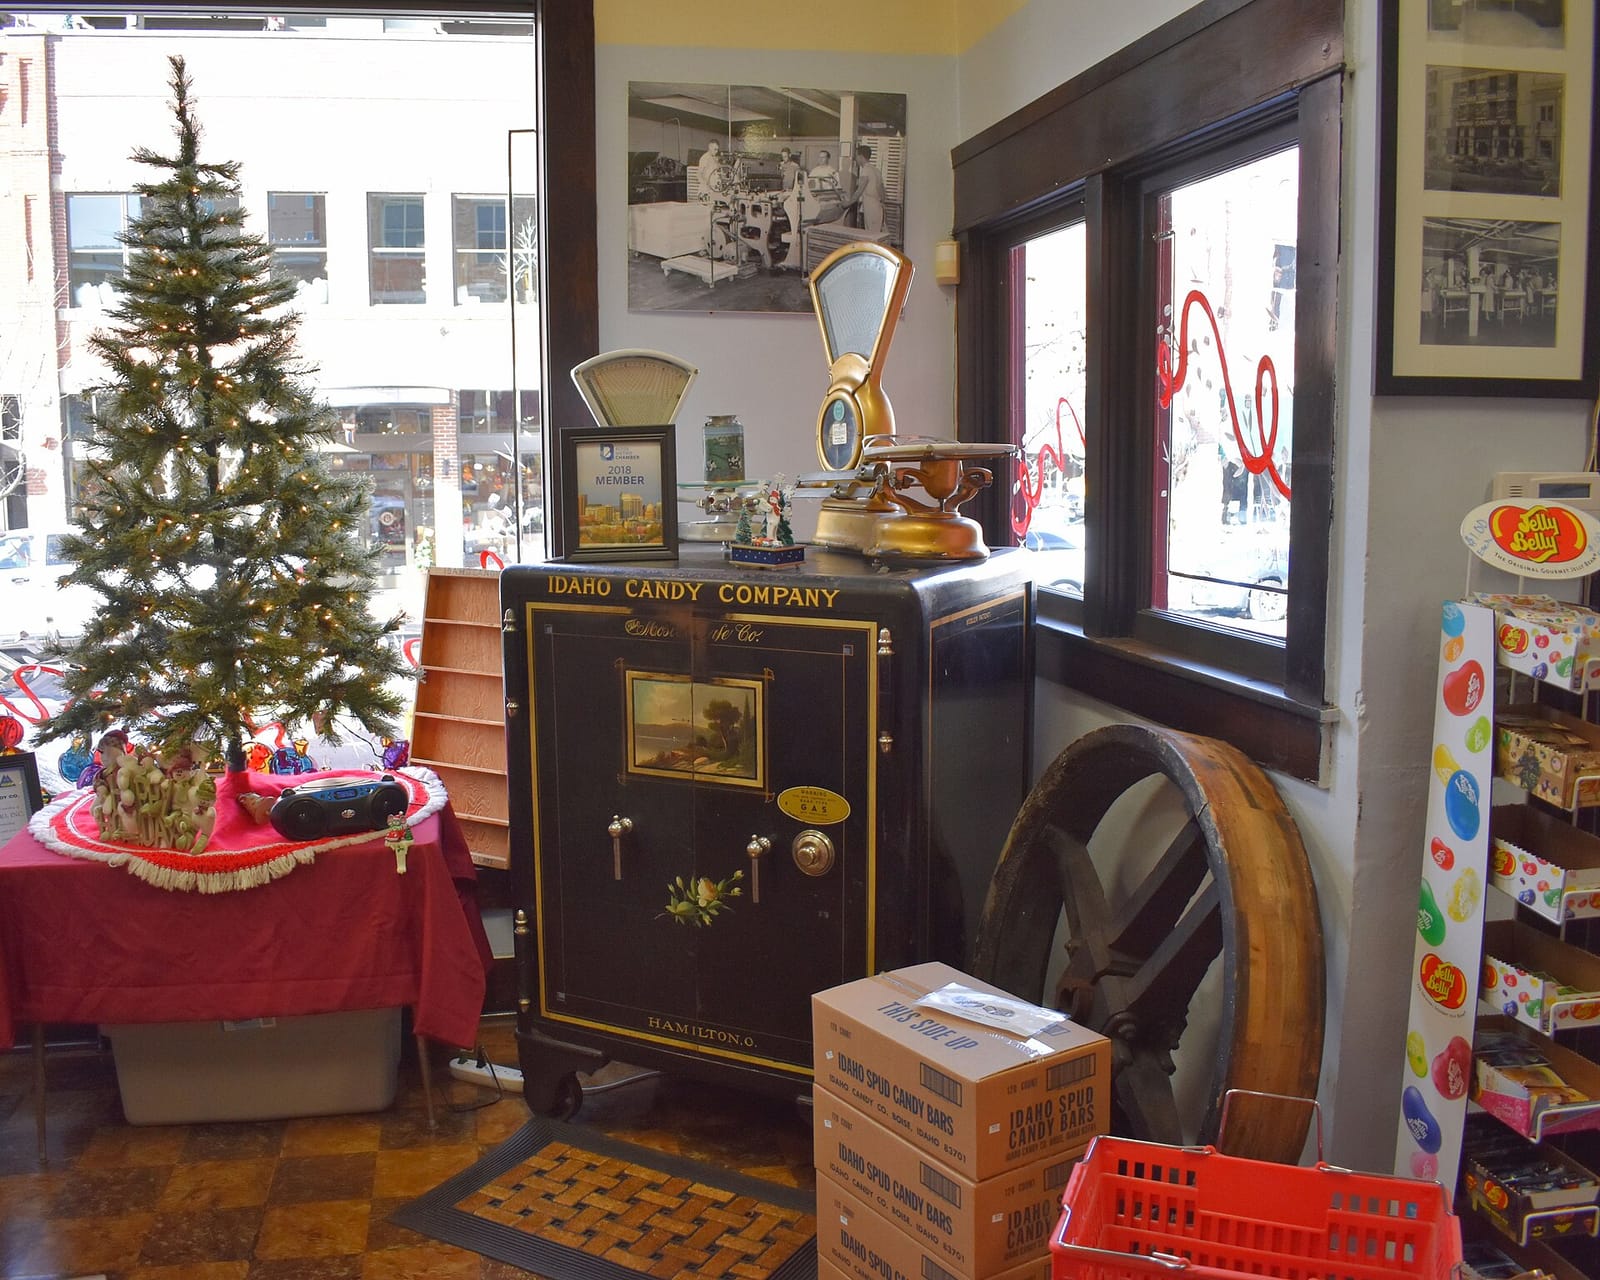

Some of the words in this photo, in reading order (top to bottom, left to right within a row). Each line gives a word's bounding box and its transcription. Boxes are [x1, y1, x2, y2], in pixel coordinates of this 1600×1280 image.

[595, 476, 645, 486] MEMBER
[608, 465, 632, 475] 2018
[1518, 506, 1560, 537] Jelly
[1509, 531, 1558, 558] Belly
[548, 575, 611, 596] IDAHO
[625, 579, 705, 601] CANDY
[718, 584, 841, 608] COMPANY
[735, 623, 763, 643] Co.
[800, 803, 828, 813] GAS
[876, 1000, 914, 1024] THIS
[910, 1018, 957, 1041] SIDE
[944, 1035, 979, 1051] UP
[829, 1073, 849, 1092] IDAHO
[851, 1087, 873, 1107] CANDY
[916, 1127, 940, 1148] IDAHO
[837, 1051, 865, 1083] IDAHO
[866, 1069, 891, 1099] SPUD
[893, 1084, 925, 1119] CANDY
[926, 1103, 955, 1137] BARS
[1009, 1099, 1053, 1130] IDAHO
[1059, 1086, 1094, 1114] SPUD
[1008, 1117, 1054, 1150] CANDY
[1060, 1103, 1095, 1132] BARS
[838, 1141, 865, 1175] IDAHO
[866, 1161, 891, 1193] SPUD
[893, 1180, 925, 1216] CANDY
[926, 1202, 953, 1236] BARS
[1007, 1199, 1050, 1231] IDAHO
[916, 1223, 939, 1245] IDAHO
[1006, 1217, 1050, 1250] CANDY
[841, 1228, 867, 1263] IDAHO
[868, 1250, 893, 1280] SPUD
